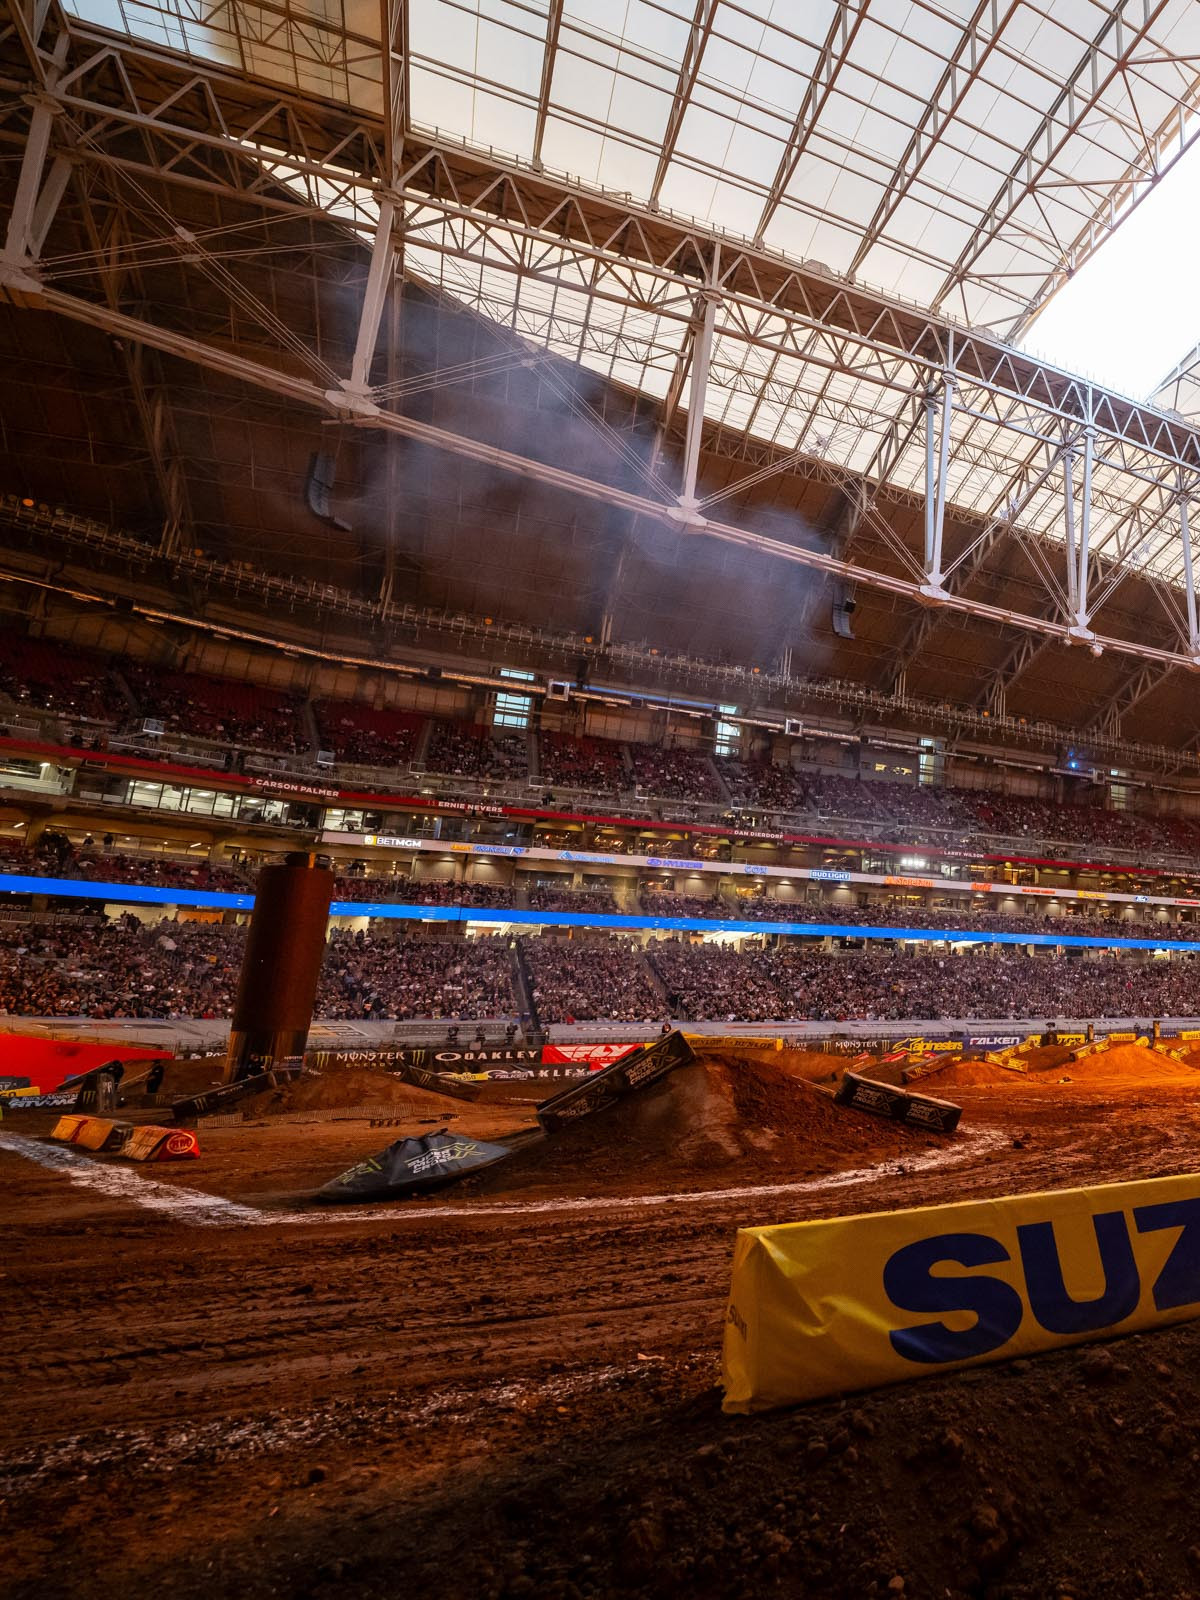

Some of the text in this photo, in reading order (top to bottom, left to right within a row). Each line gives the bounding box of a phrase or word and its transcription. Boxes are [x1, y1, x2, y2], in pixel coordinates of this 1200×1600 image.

[255, 779, 298, 791] CARSON
[300, 784, 339, 797] PALMER
[438, 801, 465, 810] ERNIE
[467, 803, 503, 814] NEVERS
[750, 832, 784, 840] DIERDORF
[376, 837, 422, 848] BETMGM
[812, 871, 849, 880] BUD LIGHT
[835, 1040, 878, 1049] MONSTER
[970, 1036, 1020, 1045] FALKEN
[554, 1045, 635, 1058] FLY
[914, 1040, 964, 1056] alpinestars
[336, 1051, 405, 1062] MONSTER
[464, 1051, 537, 1061] OAKLEY
